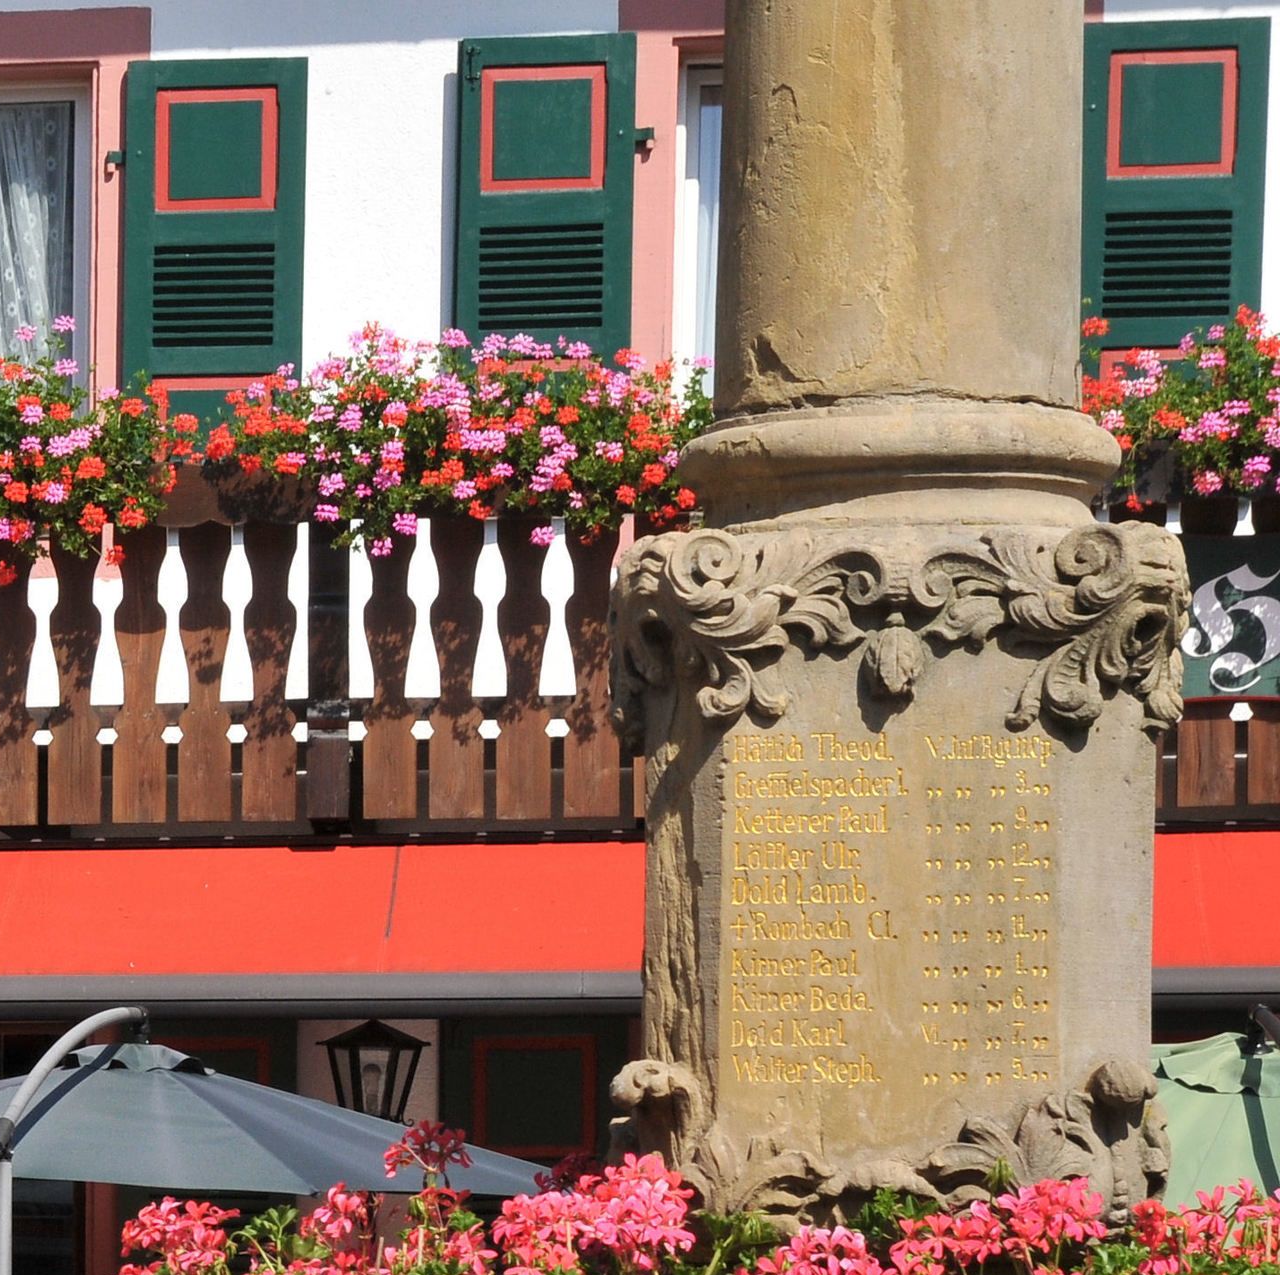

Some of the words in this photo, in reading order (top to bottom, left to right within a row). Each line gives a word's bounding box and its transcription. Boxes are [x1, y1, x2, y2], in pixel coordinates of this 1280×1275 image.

[810, 731, 895, 762] Theod.
[733, 804, 836, 834] Ketterer
[838, 803, 890, 834] Paul
[734, 840, 815, 871] Löffler
[731, 873, 788, 906] Dold
[731, 947, 806, 977] Kirner
[809, 948, 860, 977] Paul
[791, 1017, 848, 1048] Karl
